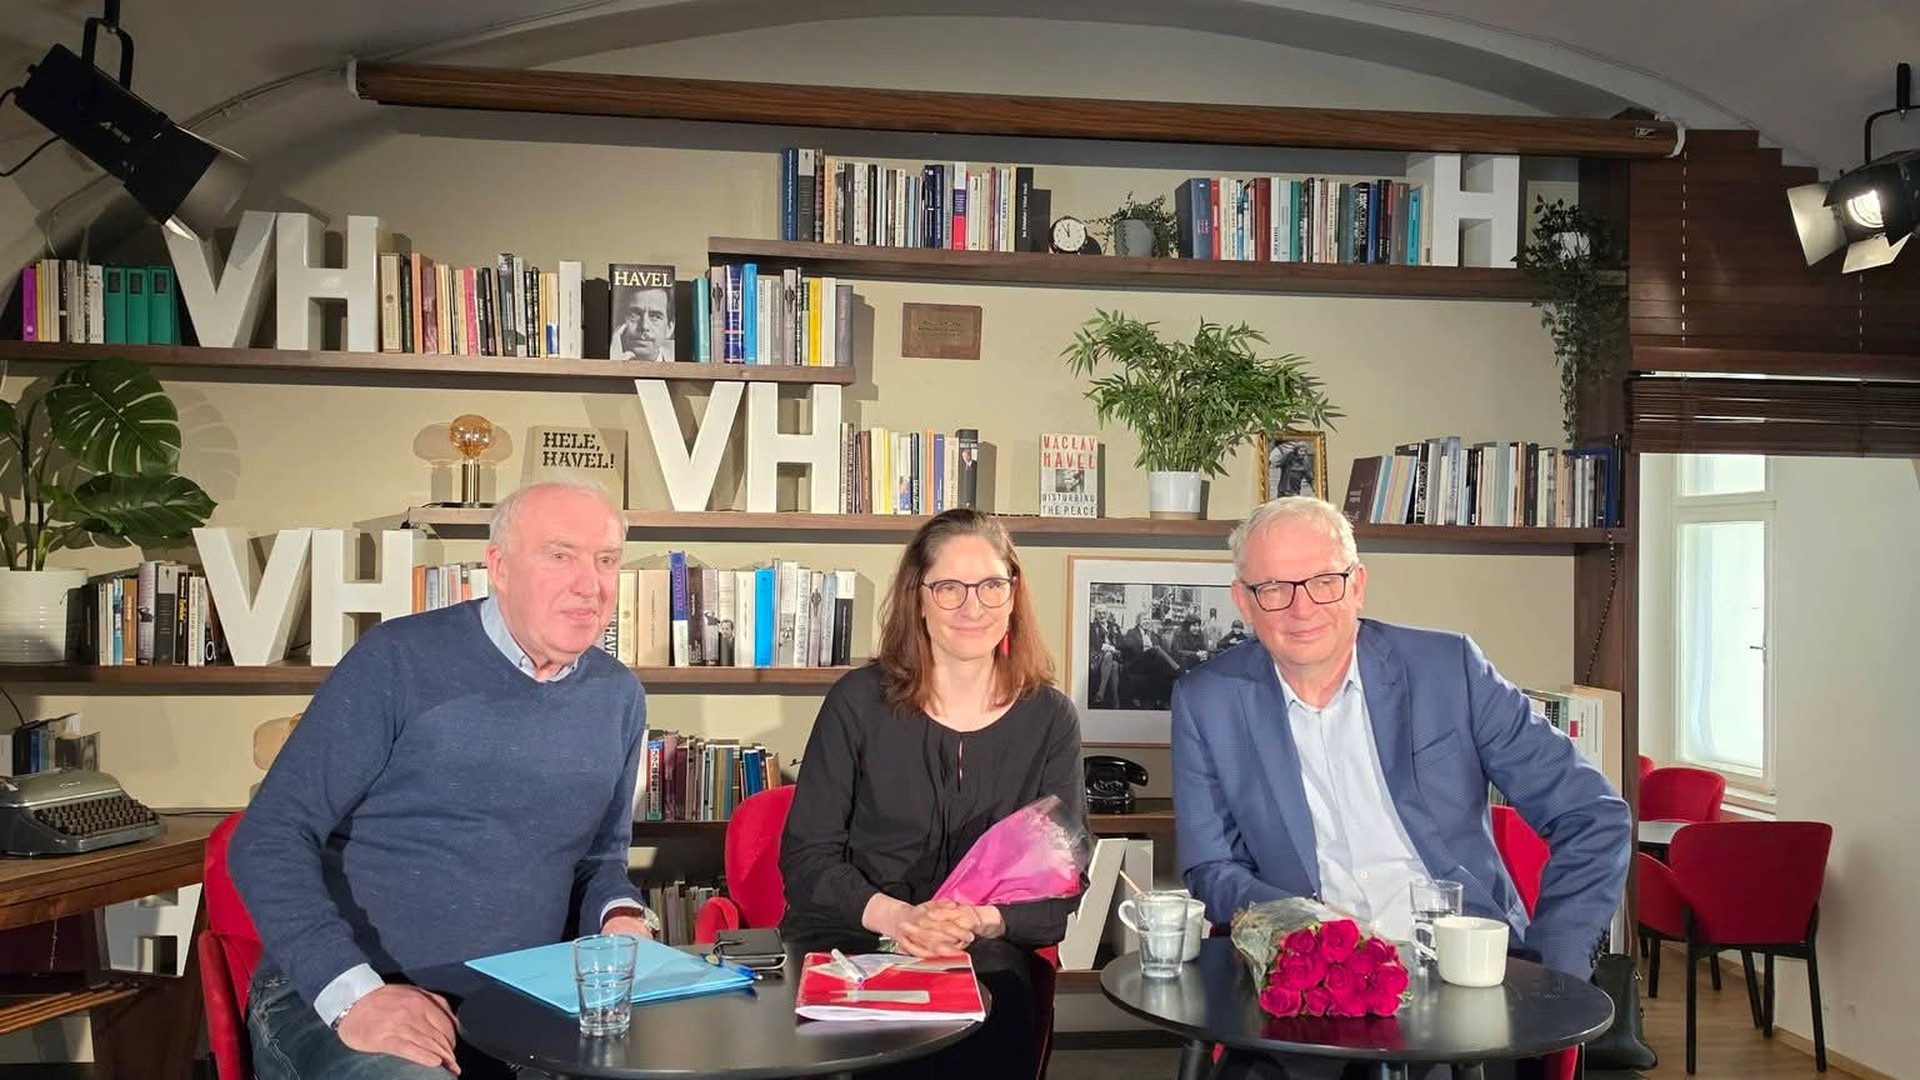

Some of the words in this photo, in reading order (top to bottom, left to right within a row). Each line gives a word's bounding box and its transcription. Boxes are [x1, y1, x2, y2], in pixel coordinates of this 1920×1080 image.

[163, 211, 379, 353] VH
[613, 271, 673, 288] HAVEL
[542, 431, 601, 451] HELE,
[634, 378, 842, 514] VH
[542, 451, 615, 469] HAVEL!
[1043, 452, 1095, 470] HAVEL
[1041, 493, 1096, 503] DISTURBING
[1041, 505, 1060, 515] THE
[1063, 505, 1095, 516] PEACE
[192, 527, 415, 667] VH
